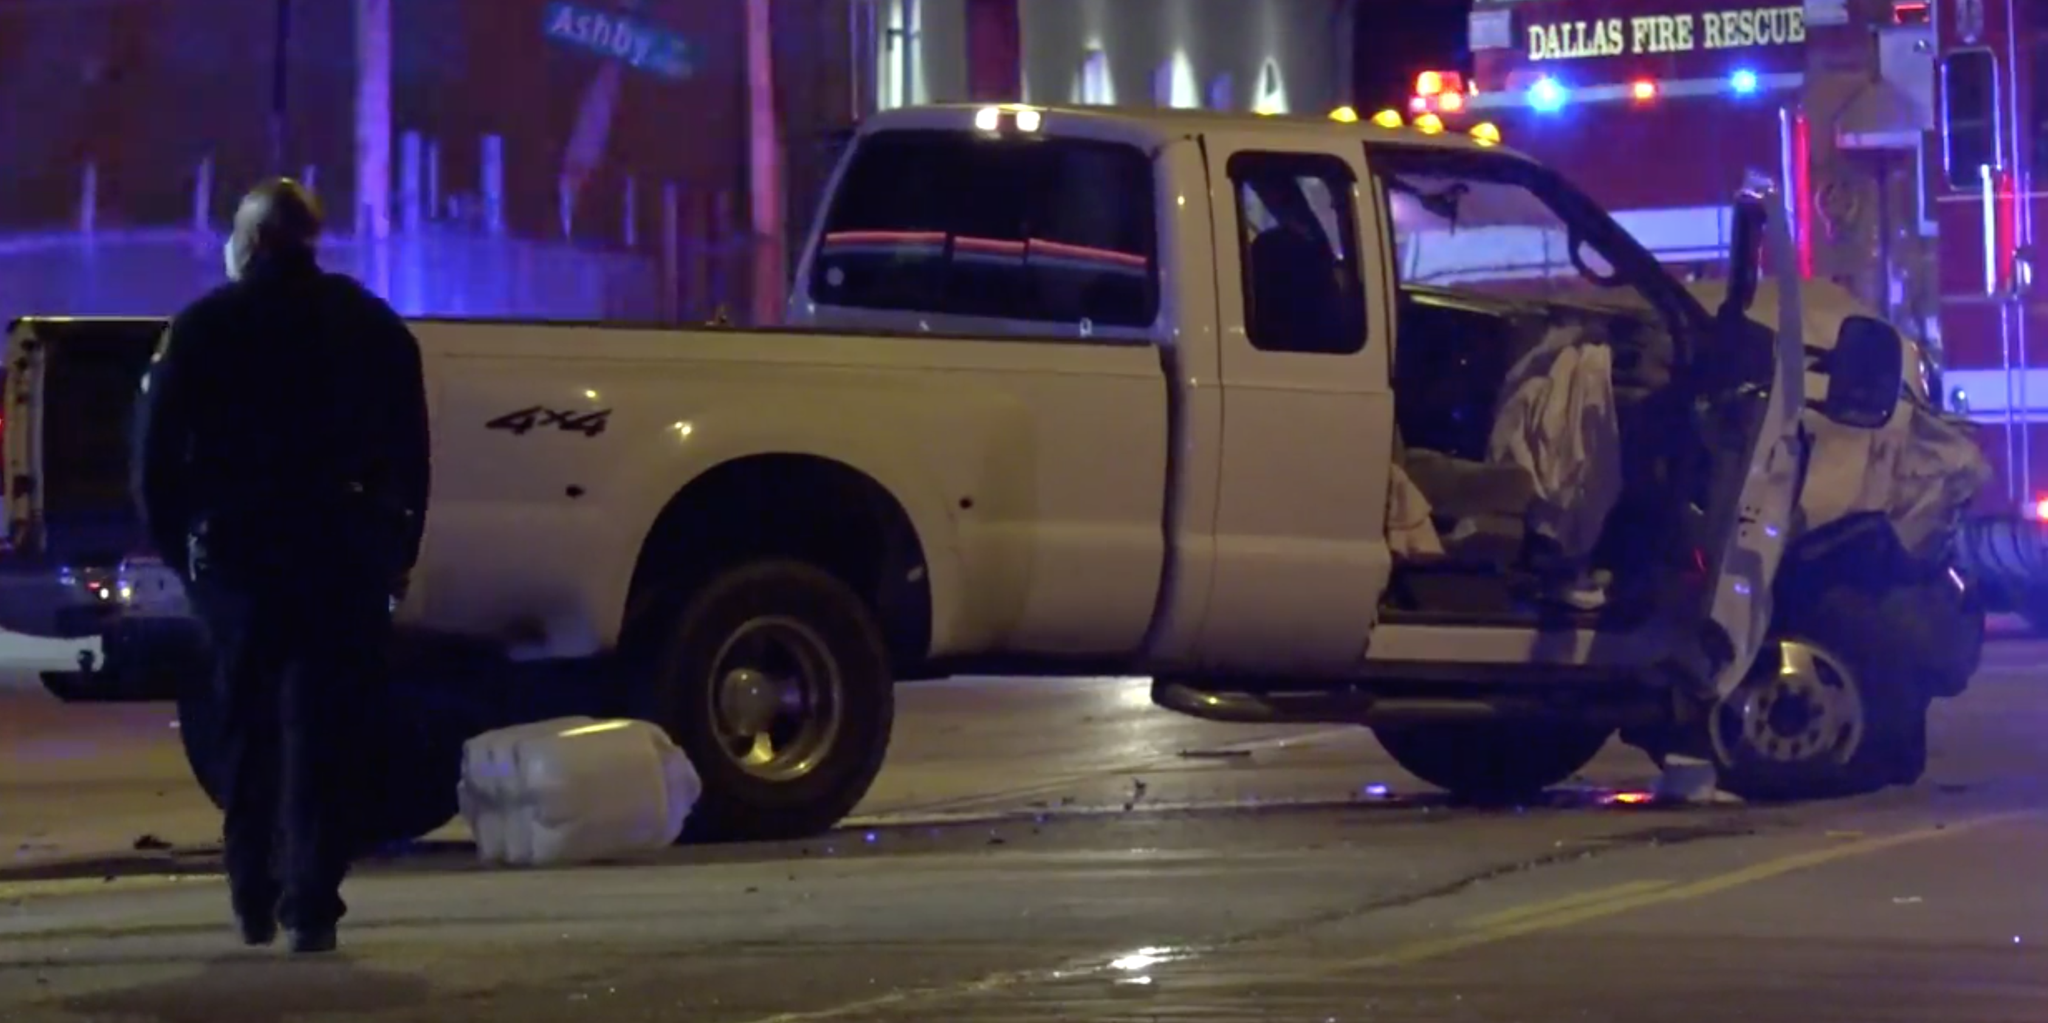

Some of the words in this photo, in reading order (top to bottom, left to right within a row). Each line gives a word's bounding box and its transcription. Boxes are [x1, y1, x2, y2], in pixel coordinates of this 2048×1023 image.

[551, 6, 650, 66] Ashby
[1528, 19, 1623, 60] DALLAS
[1631, 15, 1694, 53] FIRE
[1703, 7, 1805, 48] RESCUE
[485, 405, 613, 437] 4x4
